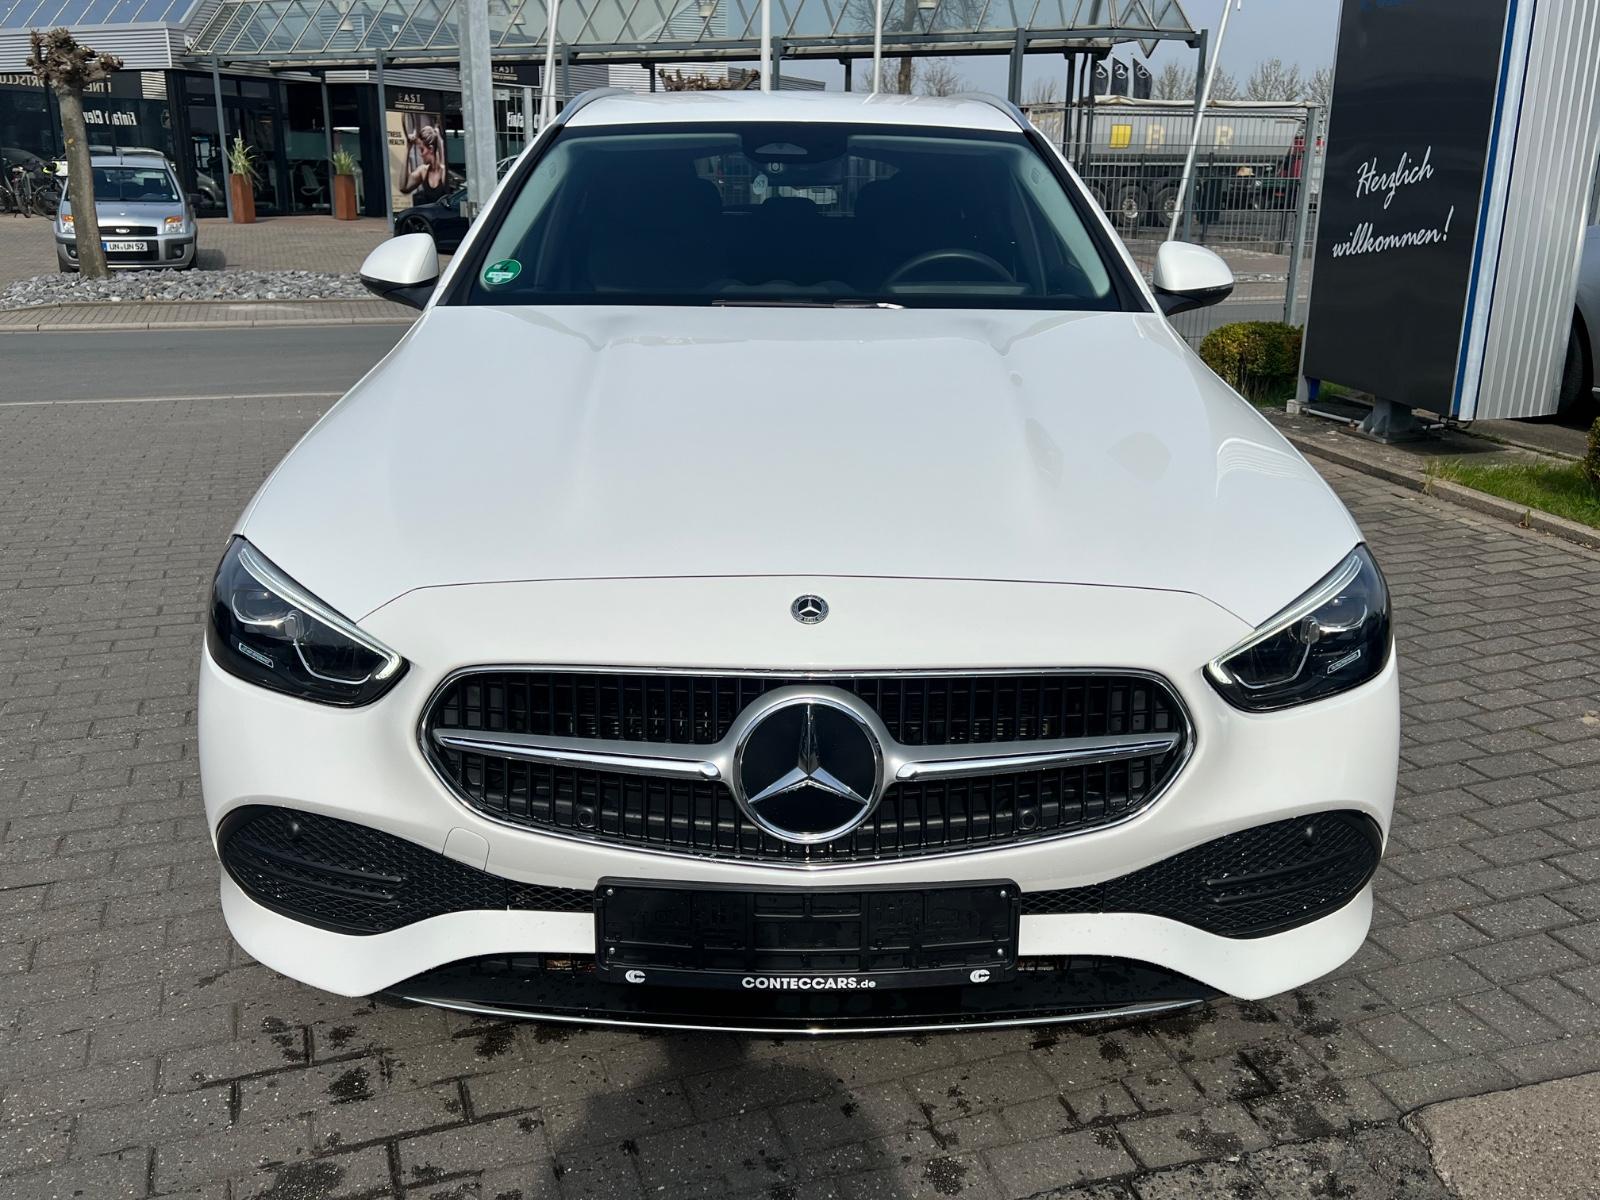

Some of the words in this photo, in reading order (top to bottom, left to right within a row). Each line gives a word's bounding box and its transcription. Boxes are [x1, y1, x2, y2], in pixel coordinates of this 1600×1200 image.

[398, 93, 421, 103] EAST
[1356, 145, 1434, 209] Herzlich
[1332, 205, 1454, 258] willkommen!
[742, 976, 876, 990] CONTECCARS.de
